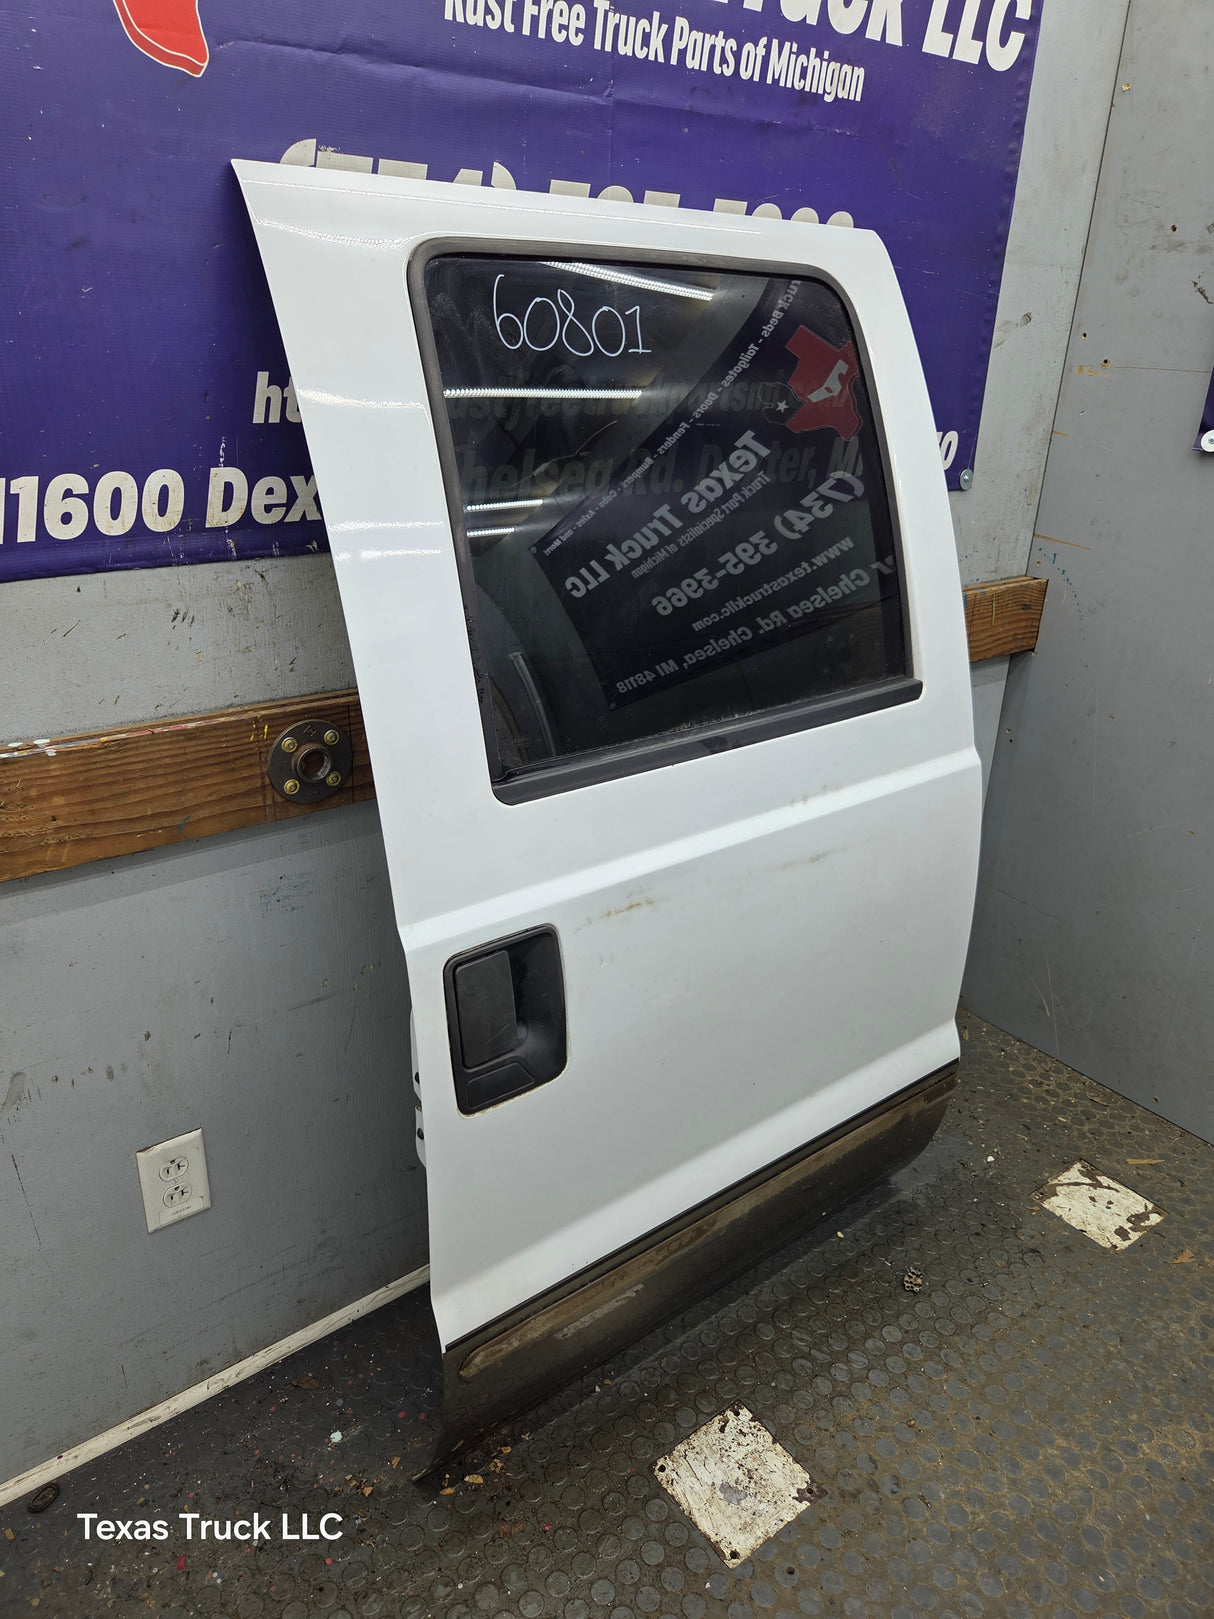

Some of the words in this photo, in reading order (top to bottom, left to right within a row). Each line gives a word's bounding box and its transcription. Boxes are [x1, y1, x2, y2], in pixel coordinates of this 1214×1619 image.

[522, 0, 586, 46] Free
[593, 0, 669, 63] Truck
[670, 16, 737, 77] Parts
[739, 36, 768, 82] of
[766, 38, 865, 103] Michigan
[922, 0, 1033, 71] LLC
[492, 274, 652, 357] 60801
[0, 468, 185, 544] 1600
[206, 466, 324, 528] Dex
